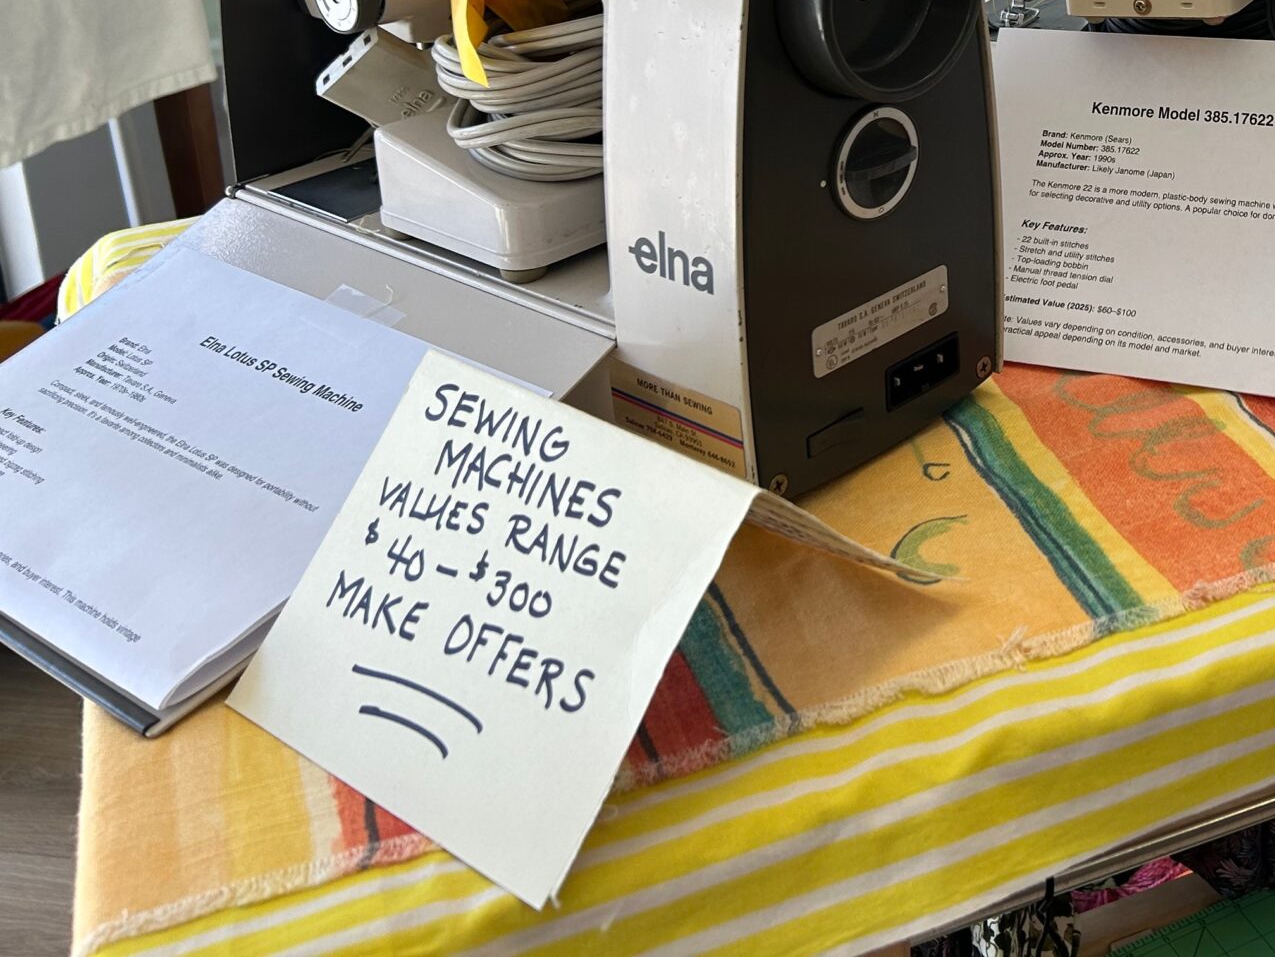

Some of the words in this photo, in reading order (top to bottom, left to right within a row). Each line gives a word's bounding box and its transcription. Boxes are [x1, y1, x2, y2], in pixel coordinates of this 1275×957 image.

[402, 89, 434, 118] elna
[1091, 101, 1154, 117] Kenmore
[1158, 106, 1200, 121] Model
[1204, 110, 1273, 126] 385.17622
[1040, 139, 1064, 148] Model
[1065, 141, 1098, 151] Number:
[1100, 144, 1140, 155] 385.17622
[1042, 129, 1068, 138] Brand:
[1069, 131, 1103, 141] Kenmore
[1104, 134, 1131, 145] (Sears)
[1037, 149, 1068, 159] Approx.
[1071, 152, 1091, 161] Year:
[1094, 154, 1115, 163] 1990s
[1036, 159, 1089, 170] Manufacturer:
[1091, 164, 1114, 175] Likely
[1114, 166, 1145, 176] Janome
[1146, 169, 1175, 180] (Japan)
[1020, 219, 1041, 230] Key
[1041, 221, 1087, 233] Features:
[1021, 235, 1032, 243] 22
[1032, 236, 1058, 246] built-in
[1059, 240, 1088, 249] stitches
[628, 230, 714, 295] elna
[892, 280, 926, 304] SWITZERLAND
[1042, 298, 1065, 308] Value
[1066, 301, 1094, 313] (2025):
[1097, 305, 1136, 317] $60–$100
[199, 336, 226, 353] Elna
[223, 346, 257, 366] Lotus
[254, 359, 277, 372] SP
[272, 367, 315, 393] Sewing
[312, 384, 362, 411] Machine
[637, 378, 658, 394] MORE
[660, 387, 681, 402] THAN
[683, 397, 713, 415] SEWING
[425, 383, 570, 462] SEWING
[434, 439, 622, 527] MACHINES
[379, 476, 490, 534] VALUES
[505, 514, 627, 589] RANGE
[326, 570, 429, 642] MAKE
[443, 614, 595, 713] OFFERS
